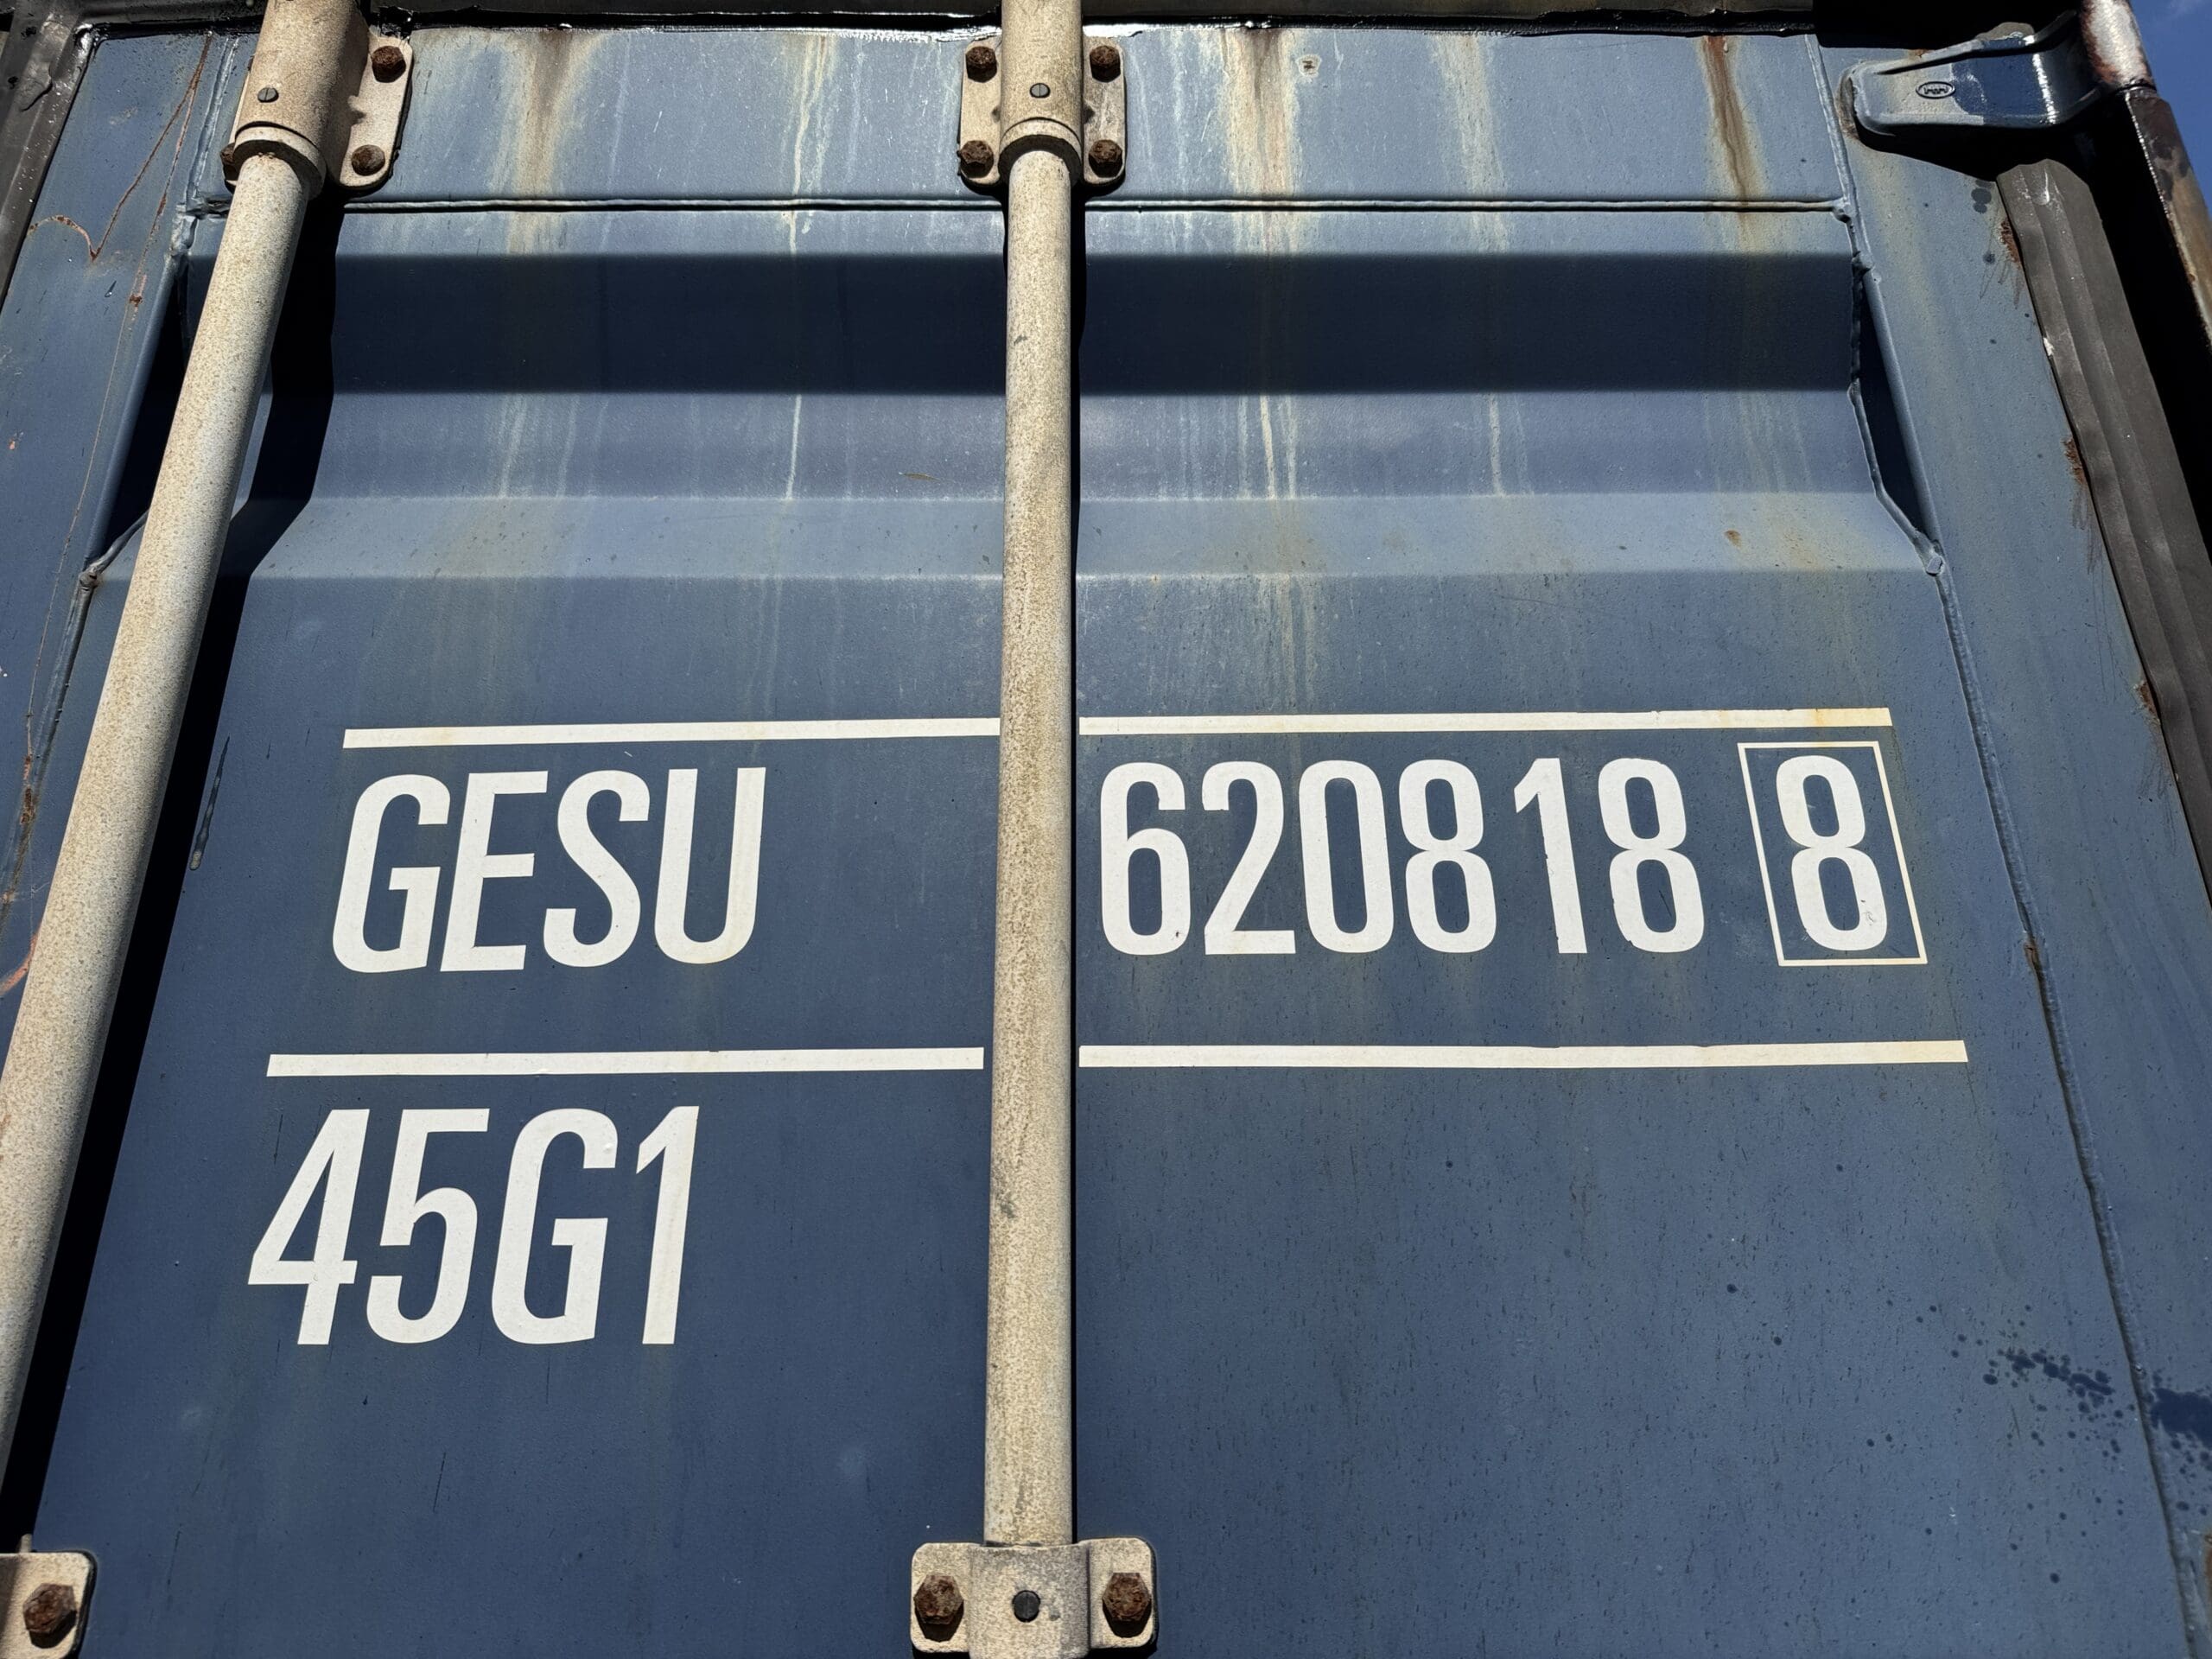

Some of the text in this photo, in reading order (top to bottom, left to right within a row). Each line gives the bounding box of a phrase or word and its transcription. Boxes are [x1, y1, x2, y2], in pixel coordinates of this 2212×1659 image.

[332, 755, 1889, 973] GESU 620818 8
[248, 1105, 699, 1345] 45G1
